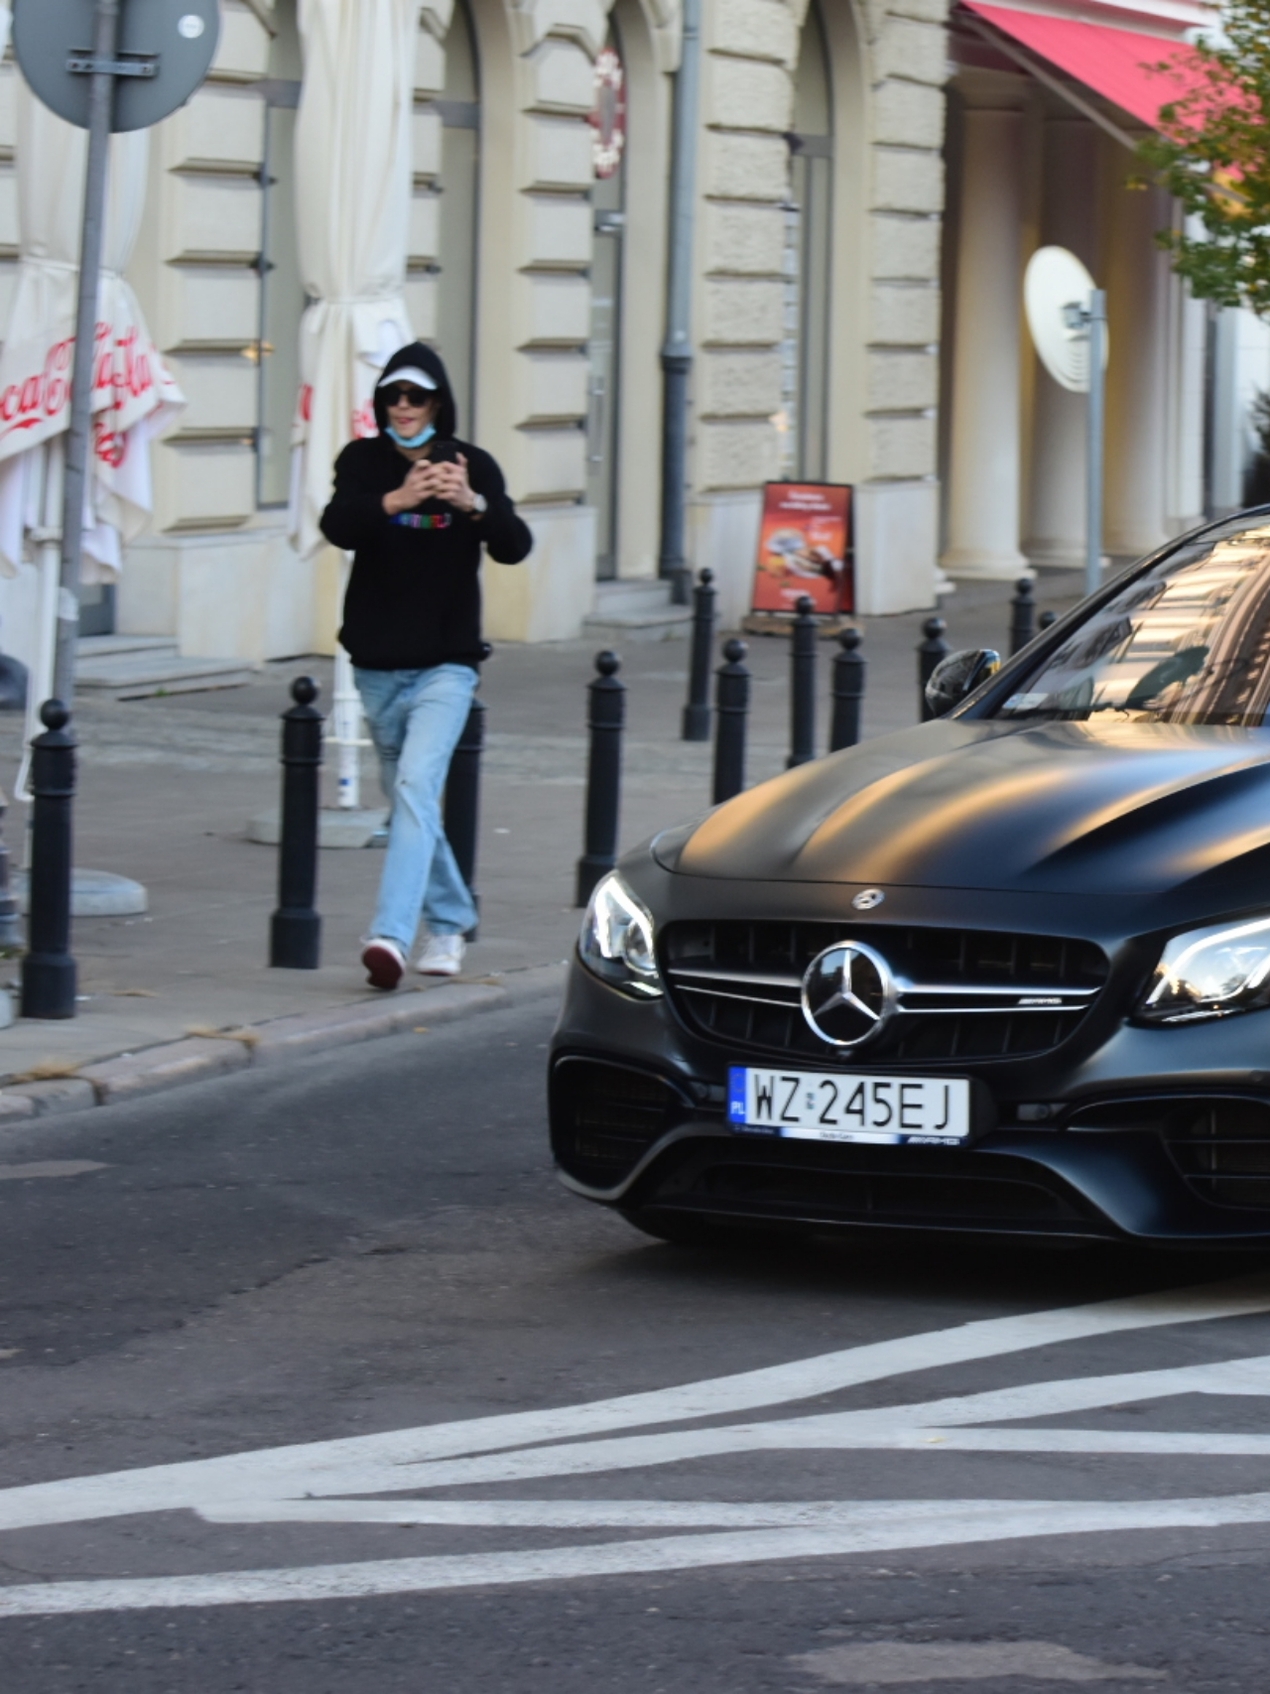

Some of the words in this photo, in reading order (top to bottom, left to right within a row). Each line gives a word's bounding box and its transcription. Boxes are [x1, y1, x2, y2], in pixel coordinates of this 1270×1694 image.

[731, 1101, 745, 1115] PL
[755, 1074, 801, 1122] WZ
[818, 1079, 950, 1131] 245EJ
